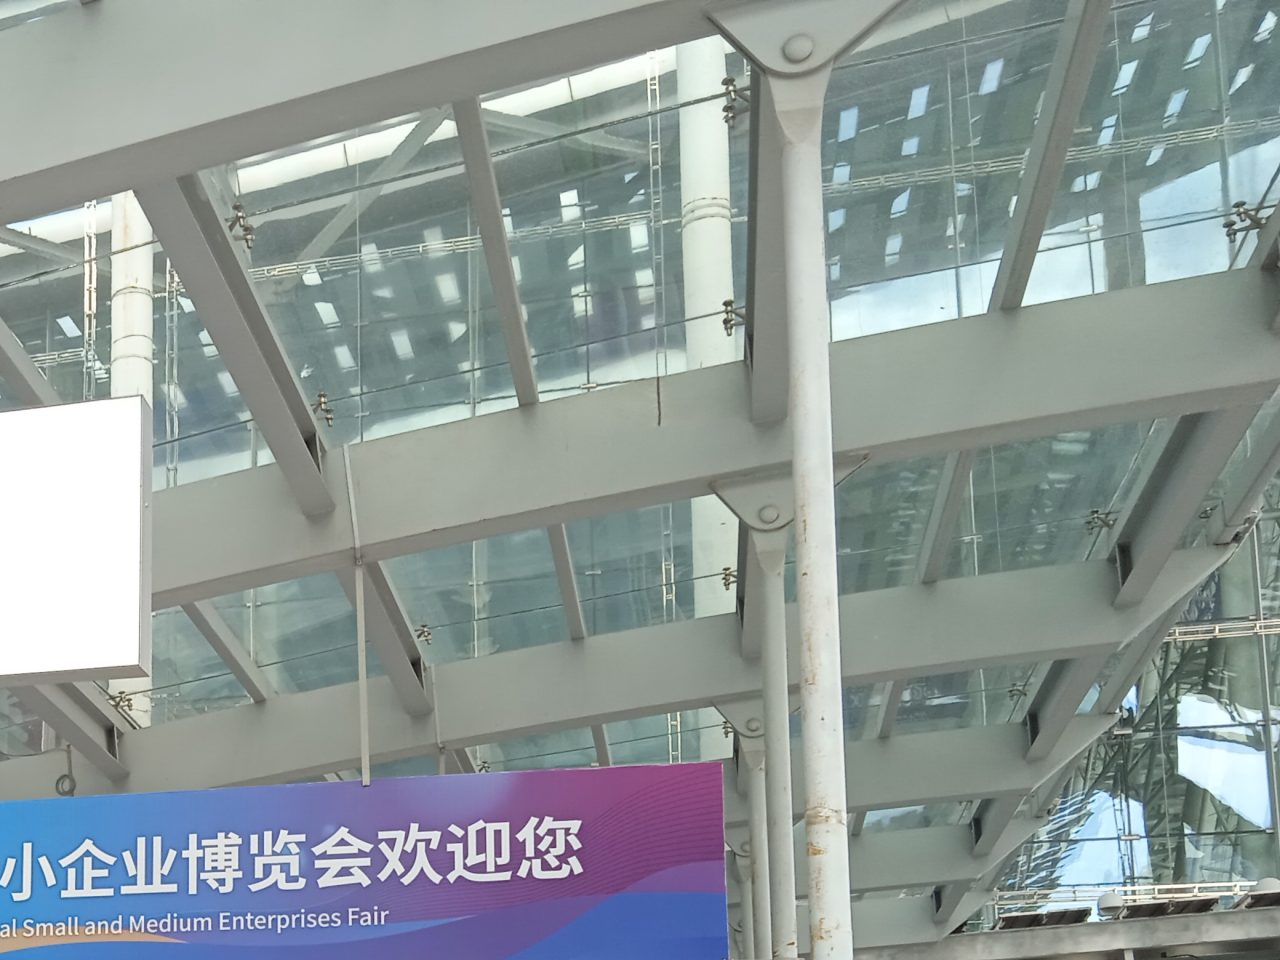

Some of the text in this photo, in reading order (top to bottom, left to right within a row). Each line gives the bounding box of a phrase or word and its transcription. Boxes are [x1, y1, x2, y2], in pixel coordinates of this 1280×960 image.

[22, 913, 80, 938] Small
[85, 914, 122, 935] and
[129, 911, 212, 934] Medium
[219, 909, 341, 934] Enterprises
[348, 906, 390, 928] Fair
